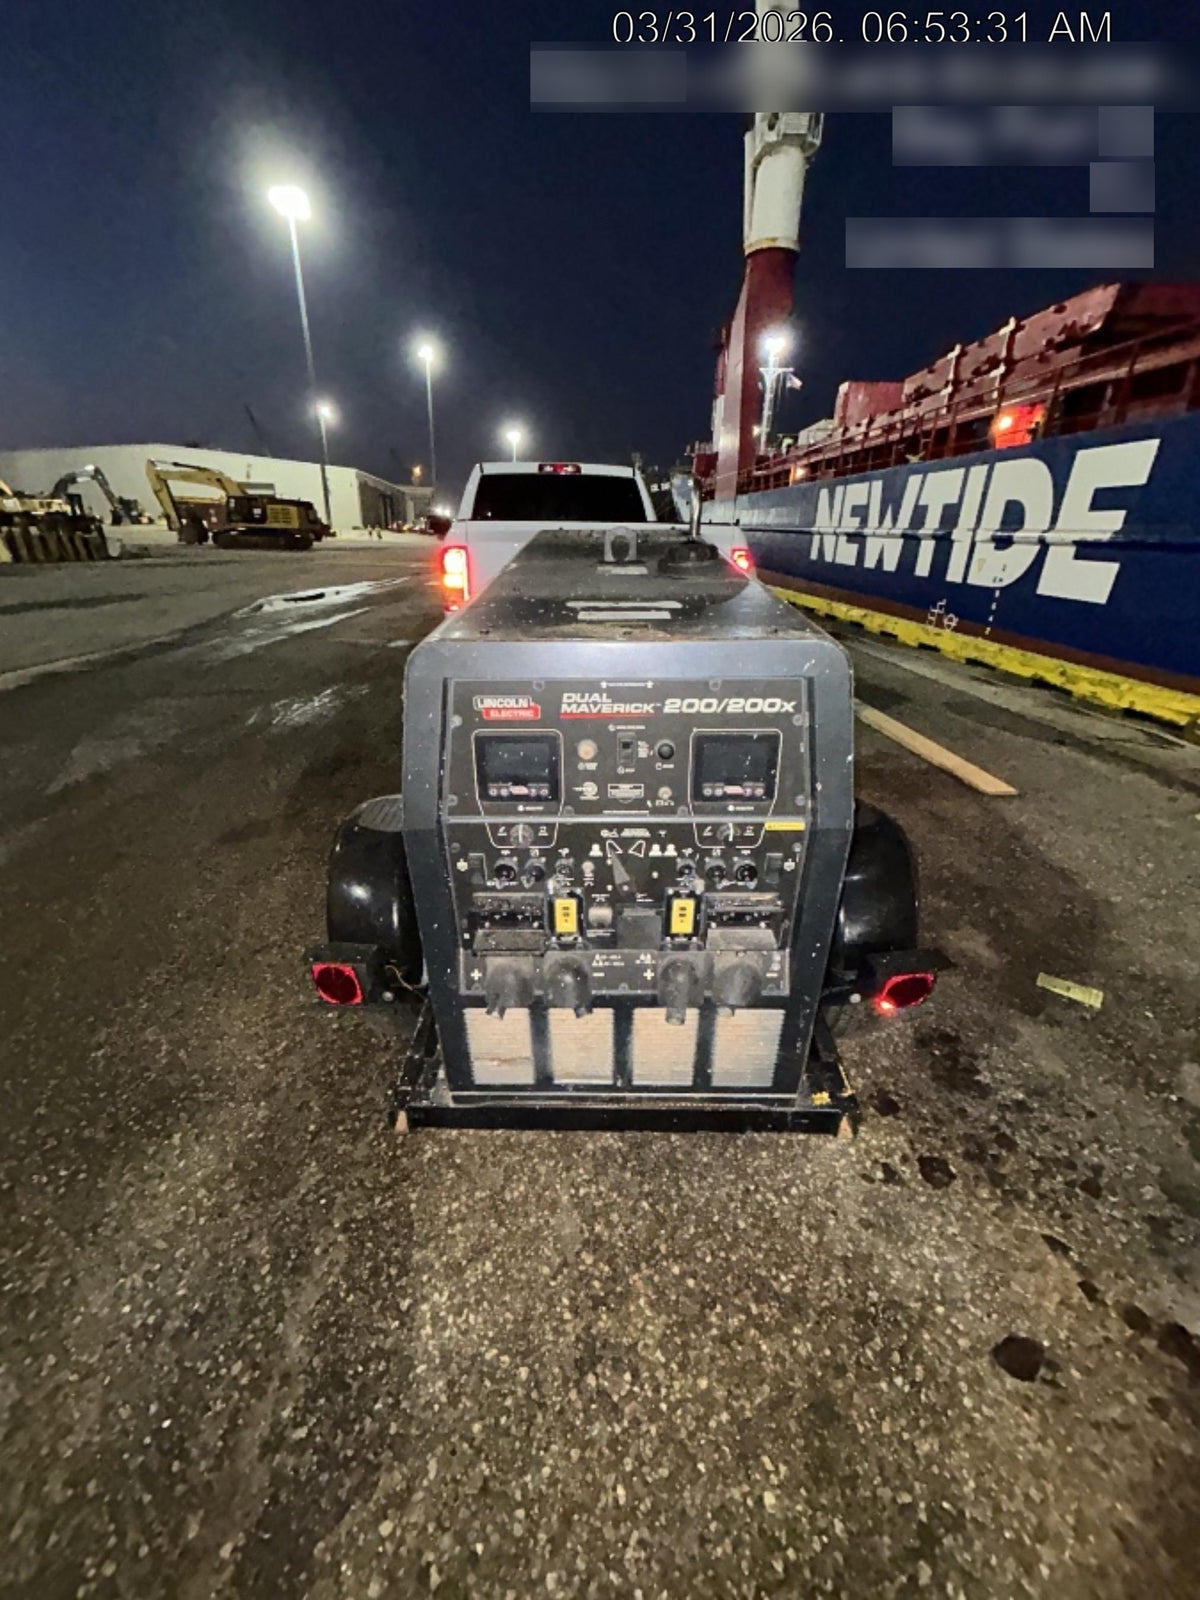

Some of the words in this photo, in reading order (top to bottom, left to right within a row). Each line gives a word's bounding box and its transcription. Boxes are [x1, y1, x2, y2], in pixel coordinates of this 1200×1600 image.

[810, 439, 1161, 604] NEWTIDE
[477, 698, 529, 708] LINCOLN
[562, 693, 612, 703] DUAL
[663, 698, 797, 714] 200/200x
[489, 709, 535, 718] ELECTRIC
